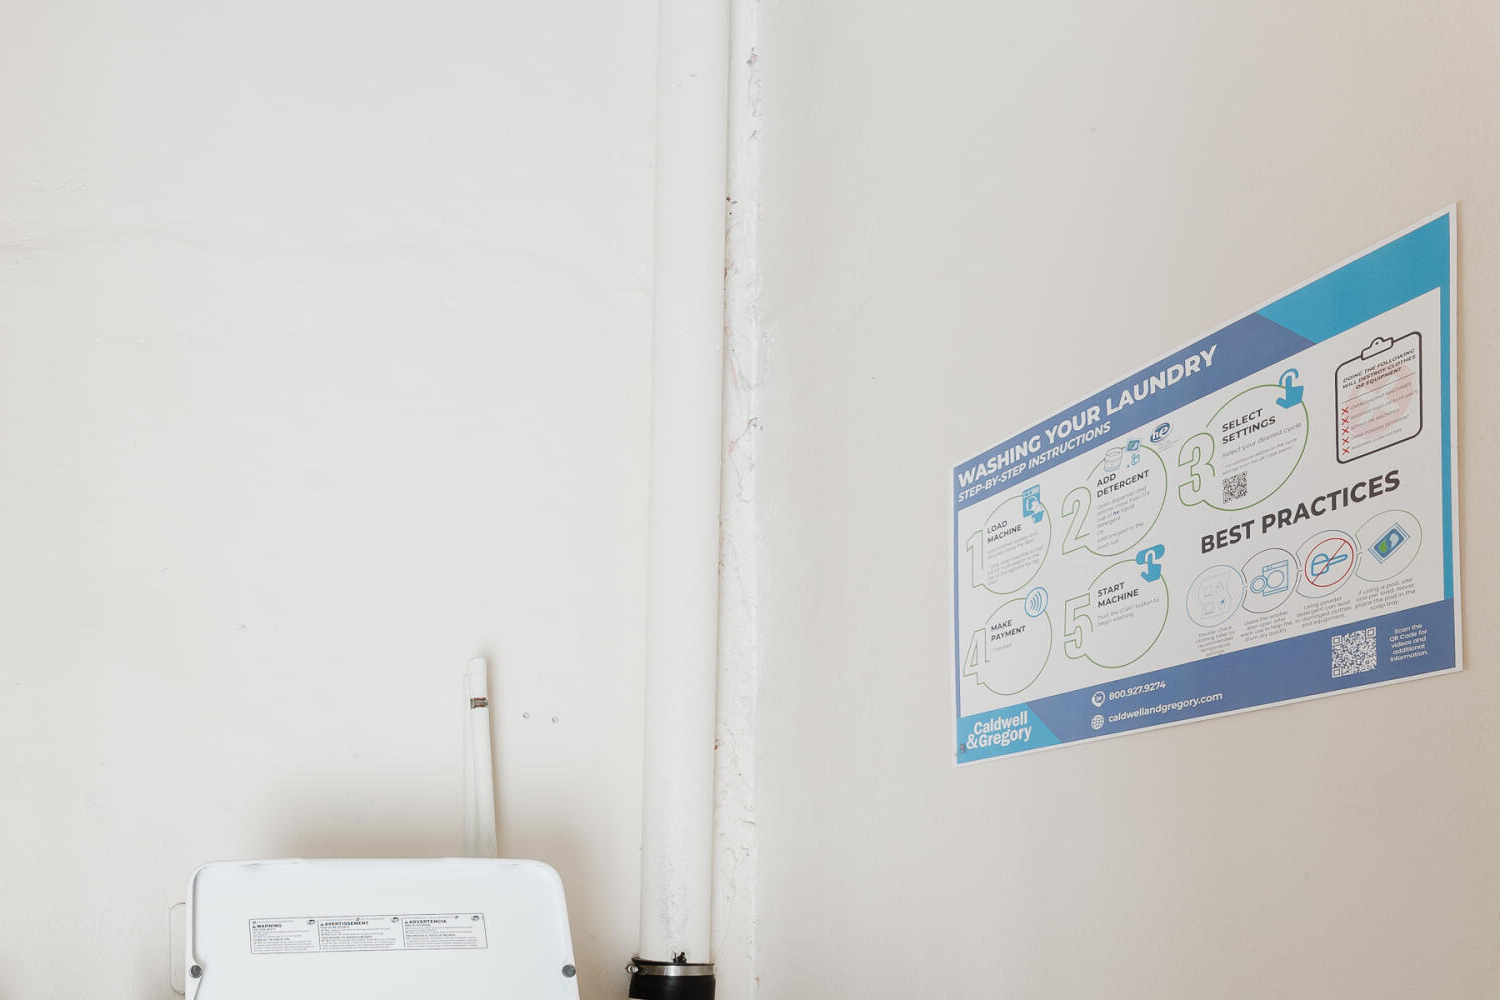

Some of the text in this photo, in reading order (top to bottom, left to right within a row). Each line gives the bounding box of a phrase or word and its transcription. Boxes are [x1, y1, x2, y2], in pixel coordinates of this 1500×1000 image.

[957, 343, 1218, 489] WASHING YOUR LAUNDRY
[1222, 408, 1263, 433] SELECT
[1222, 416, 1276, 445] SETTINGS
[957, 420, 1111, 503] STEP-BY-STEP INSTRUCTIONS
[1096, 473, 1116, 487] ADD
[1096, 469, 1150, 498] DETERGENT
[1201, 469, 1401, 554] BEST PRACTICES
[987, 520, 1008, 534] LOAD
[987, 524, 1022, 544] MACHINE
[1097, 582, 1125, 597] START
[1097, 588, 1139, 608] MACHINE
[990, 619, 1012, 631] MAKE
[990, 625, 1026, 642] PAYMENT
[1108, 680, 1166, 701] 800.927.9274
[1108, 692, 1223, 723] caldwellandgregory.com
[974, 711, 1028, 735] Caldwell
